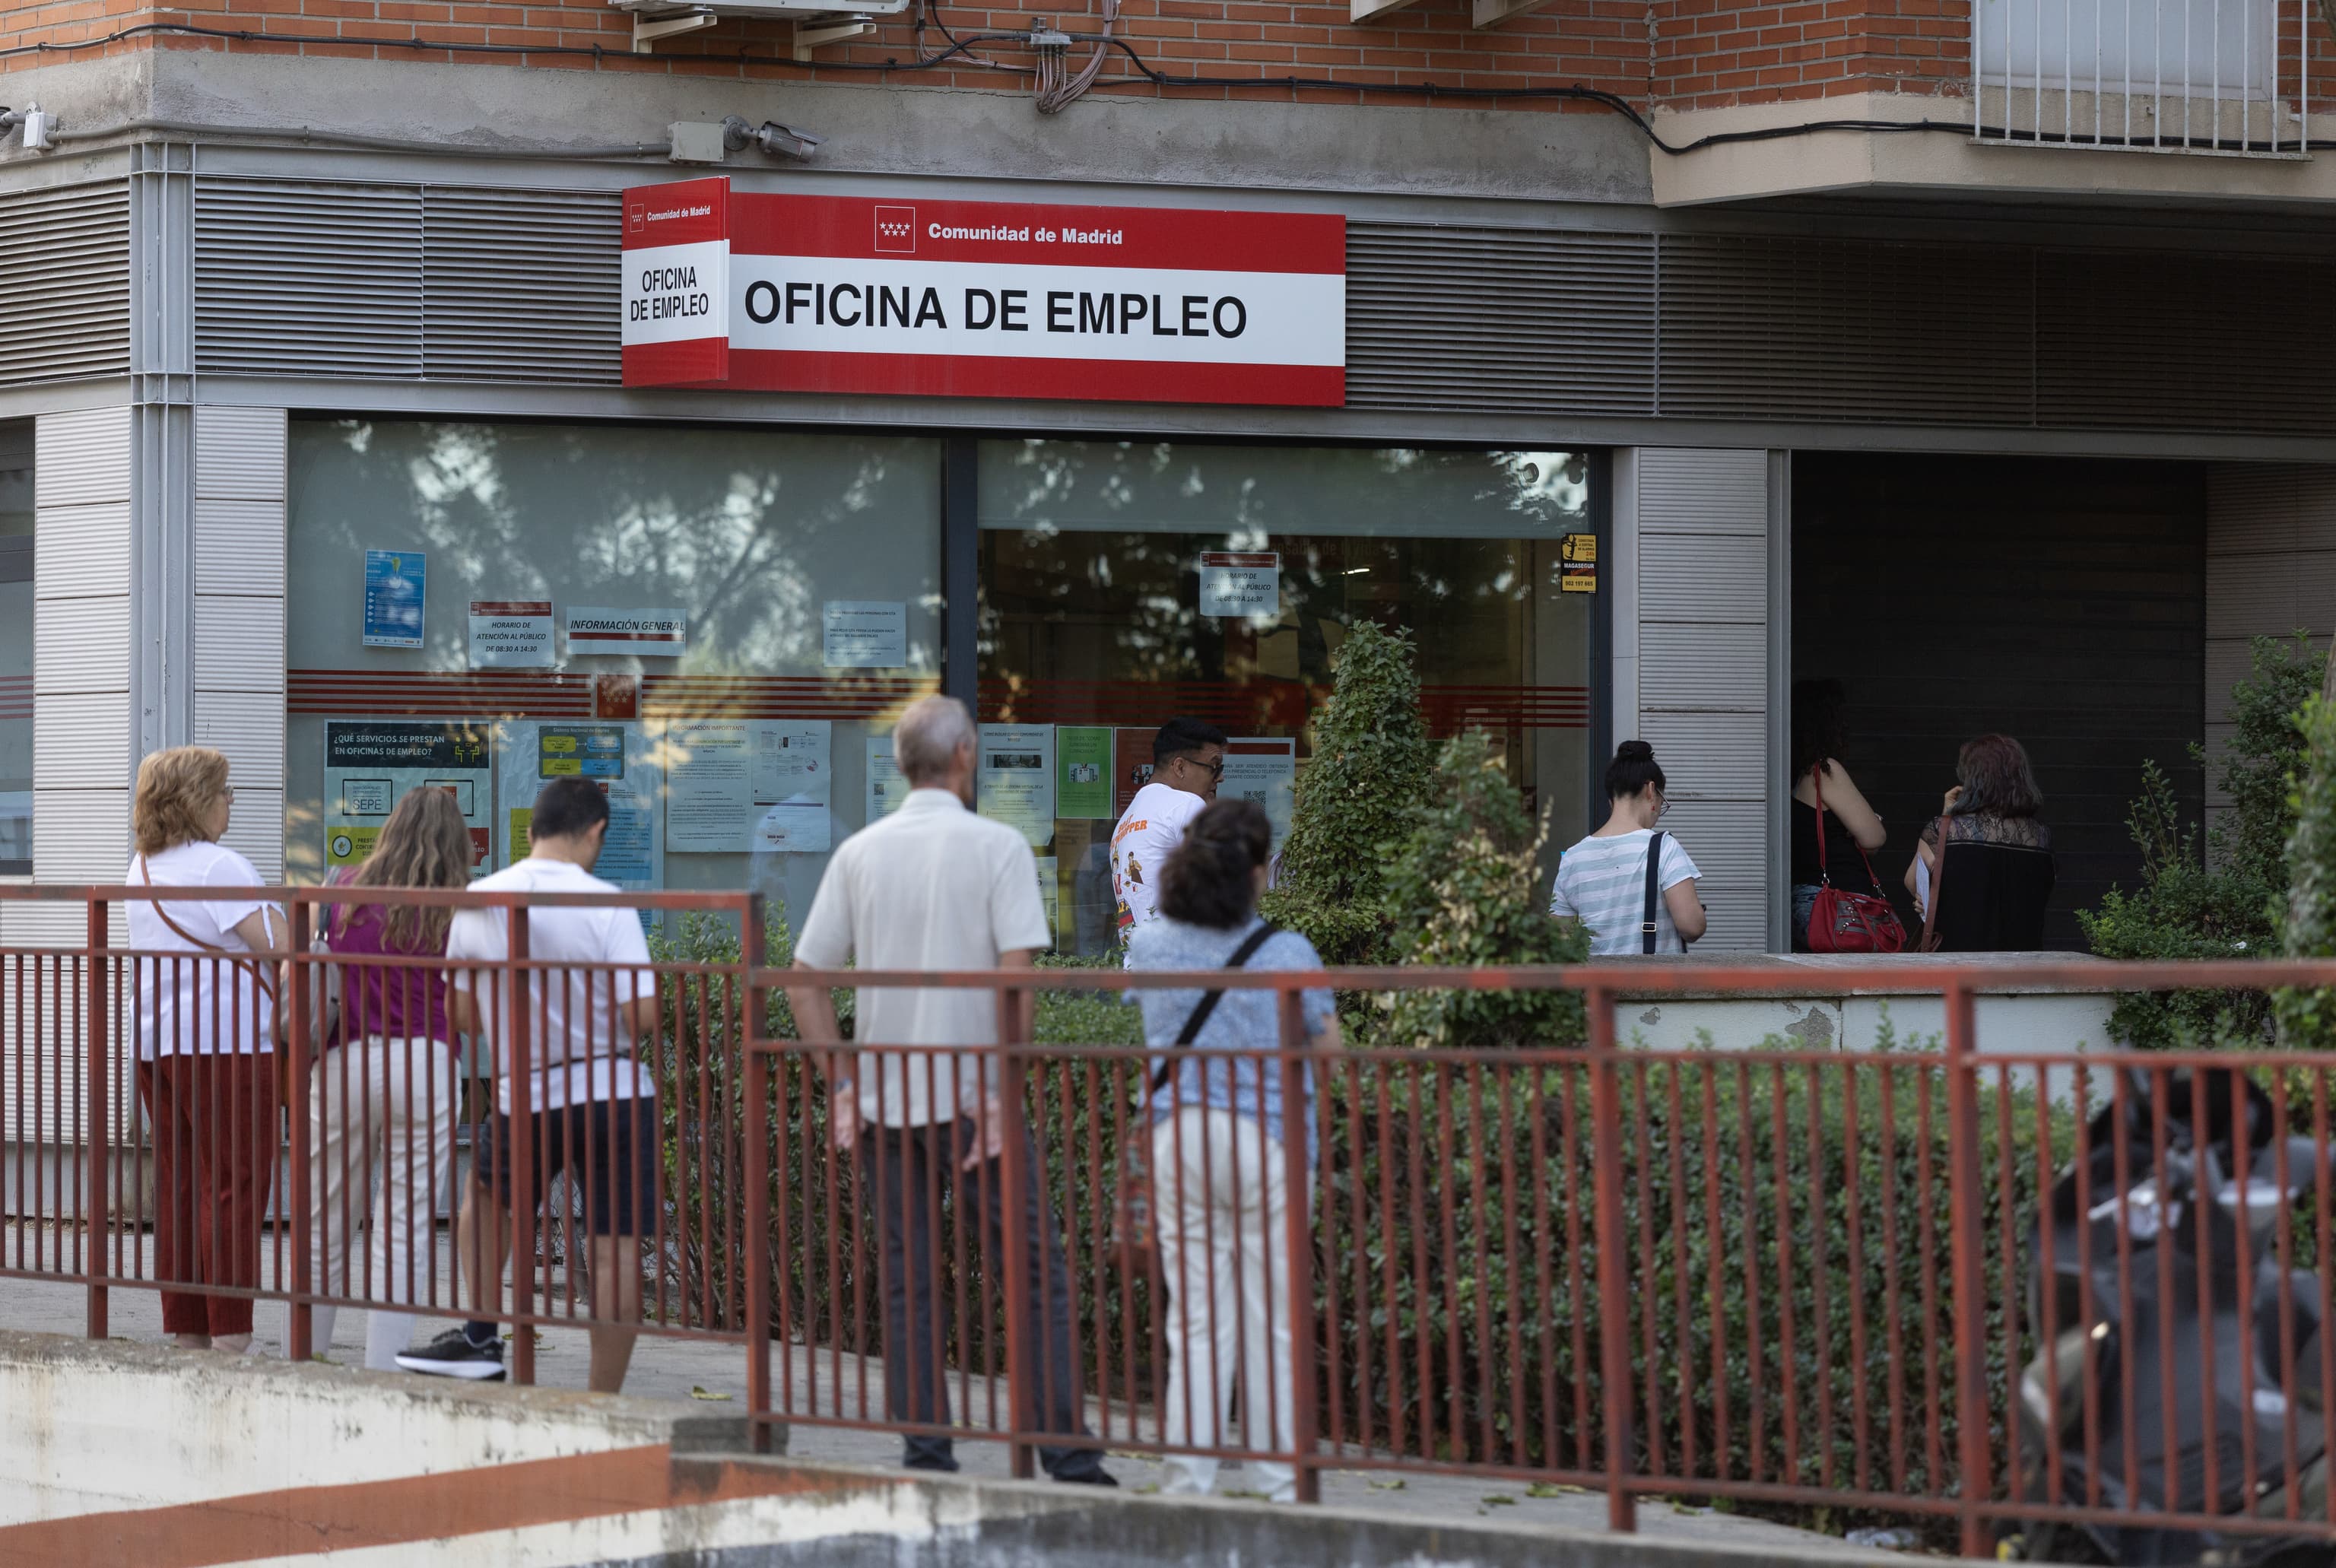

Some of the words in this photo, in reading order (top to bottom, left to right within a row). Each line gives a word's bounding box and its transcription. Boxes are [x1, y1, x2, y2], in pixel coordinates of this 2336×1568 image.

[647, 208, 680, 222] Comunidad
[681, 208, 688, 217] de
[690, 205, 710, 217] Madrid
[928, 223, 1029, 242] Comunidad
[1034, 227, 1056, 243] de
[1062, 228, 1122, 245] Madrid
[642, 266, 697, 292] OFICINA
[630, 299, 648, 322] DE
[652, 293, 709, 319] EMPLEO
[744, 280, 947, 329] OFICINA
[964, 288, 1029, 332] DE
[1046, 290, 1247, 339] EMPLEO
[570, 619, 640, 630] INFORMACIÓN
[641, 621, 684, 631] GENERAL
[334, 732, 354, 744] ¿QUÉ
[397, 747, 432, 756] EMPLEO?
[353, 798, 382, 810] SEPE
